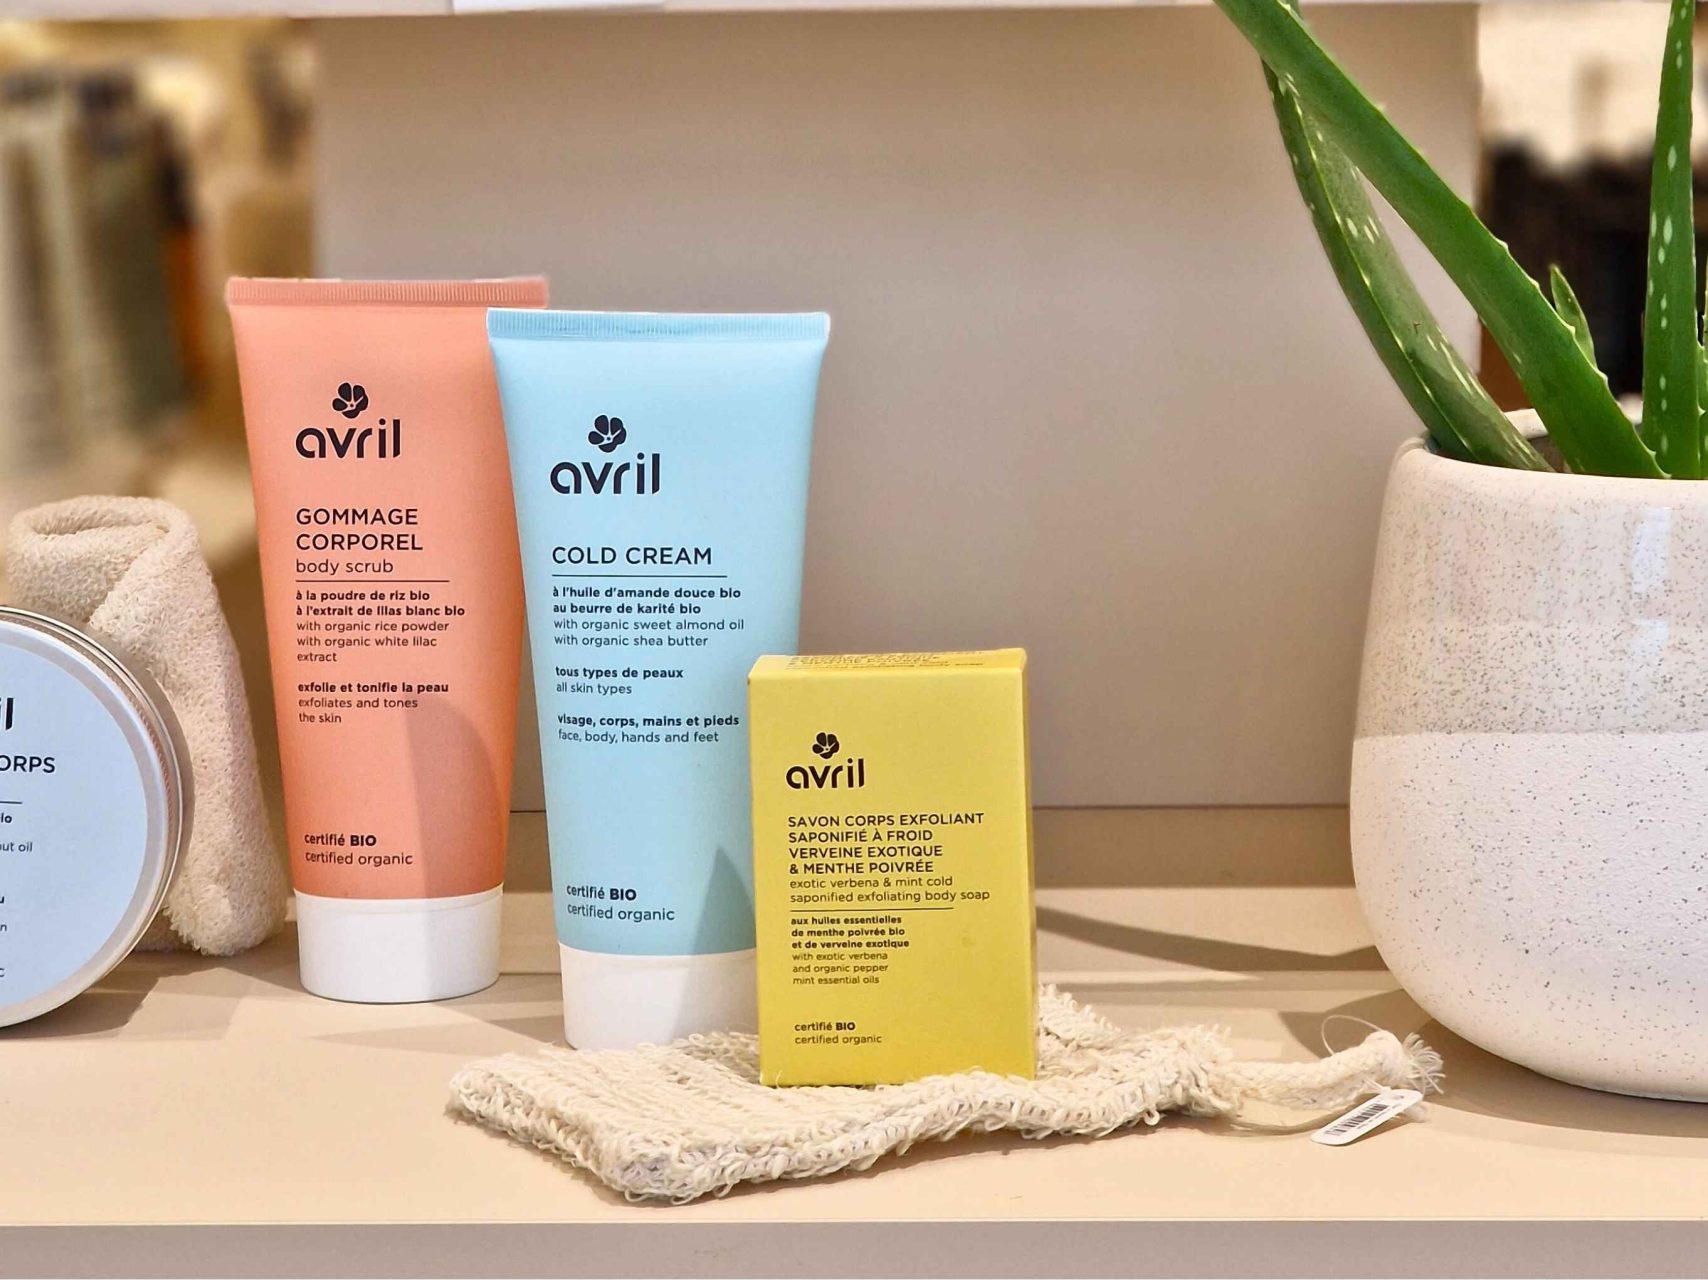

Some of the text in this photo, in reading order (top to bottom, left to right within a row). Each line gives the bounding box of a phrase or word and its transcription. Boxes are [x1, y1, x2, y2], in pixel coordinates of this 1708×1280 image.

[296, 419, 400, 458] avril
[550, 453, 660, 494] avril
[296, 507, 419, 526] GOMMAGE
[296, 533, 424, 551] CORPOREL
[552, 546, 712, 565] COLD CREAM
[296, 558, 394, 576] body scrub
[295, 589, 430, 603] à la poudre de riz bio
[552, 585, 559, 597] à
[674, 587, 716, 599] douce
[719, 587, 741, 598] bio
[296, 604, 303, 616] à
[357, 605, 373, 616] de
[376, 605, 402, 616] lilas
[405, 605, 441, 616] blanc
[444, 605, 465, 616] bio
[553, 602, 701, 614] au beurre de karité bio
[296, 620, 450, 634] with organic rice powder
[553, 618, 744, 632] with organic sweet almond oil
[296, 635, 437, 649] with organic white lilac
[554, 634, 709, 648] with organic shea butter
[296, 652, 337, 662] extract
[555, 666, 684, 681] tous types de peaux
[297, 681, 449, 695] exfolie et tonifie la peau
[556, 681, 633, 696] all skin types
[298, 696, 419, 709] exfoliates and tones
[298, 711, 342, 724] the skin
[557, 713, 740, 729] visage, corps, mains et pieds
[558, 728, 719, 745] face, body, hands and feet
[786, 758, 864, 789] avril
[788, 812, 985, 828] SAVON CORPS EXFOLIANT
[304, 833, 377, 847] certifié BIO
[788, 827, 933, 844] SAPONIFIÉ À FROID
[18, 841, 33, 852] oil
[788, 845, 943, 859] VERVEINE EXOTIQUE
[305, 851, 413, 868] certified organic
[789, 858, 934, 875] & MENTHE POIVRÉE
[789, 875, 953, 889] exotic verbena & mint cold
[566, 885, 637, 901] certifié BIO
[790, 889, 990, 905] saponified exfoliating body soap
[567, 903, 675, 923] certified organic
[790, 915, 902, 926] aux huiles essentielles
[791, 926, 906, 938] de menthe poivrée bio
[791, 938, 910, 949] et de verveine exotique
[791, 951, 888, 961] with exotic verbena
[792, 964, 889, 975] and organic pepper
[792, 975, 880, 985] mint essential oils
[794, 1021, 856, 1032] certifié BIO
[794, 1034, 882, 1046] certified organic
